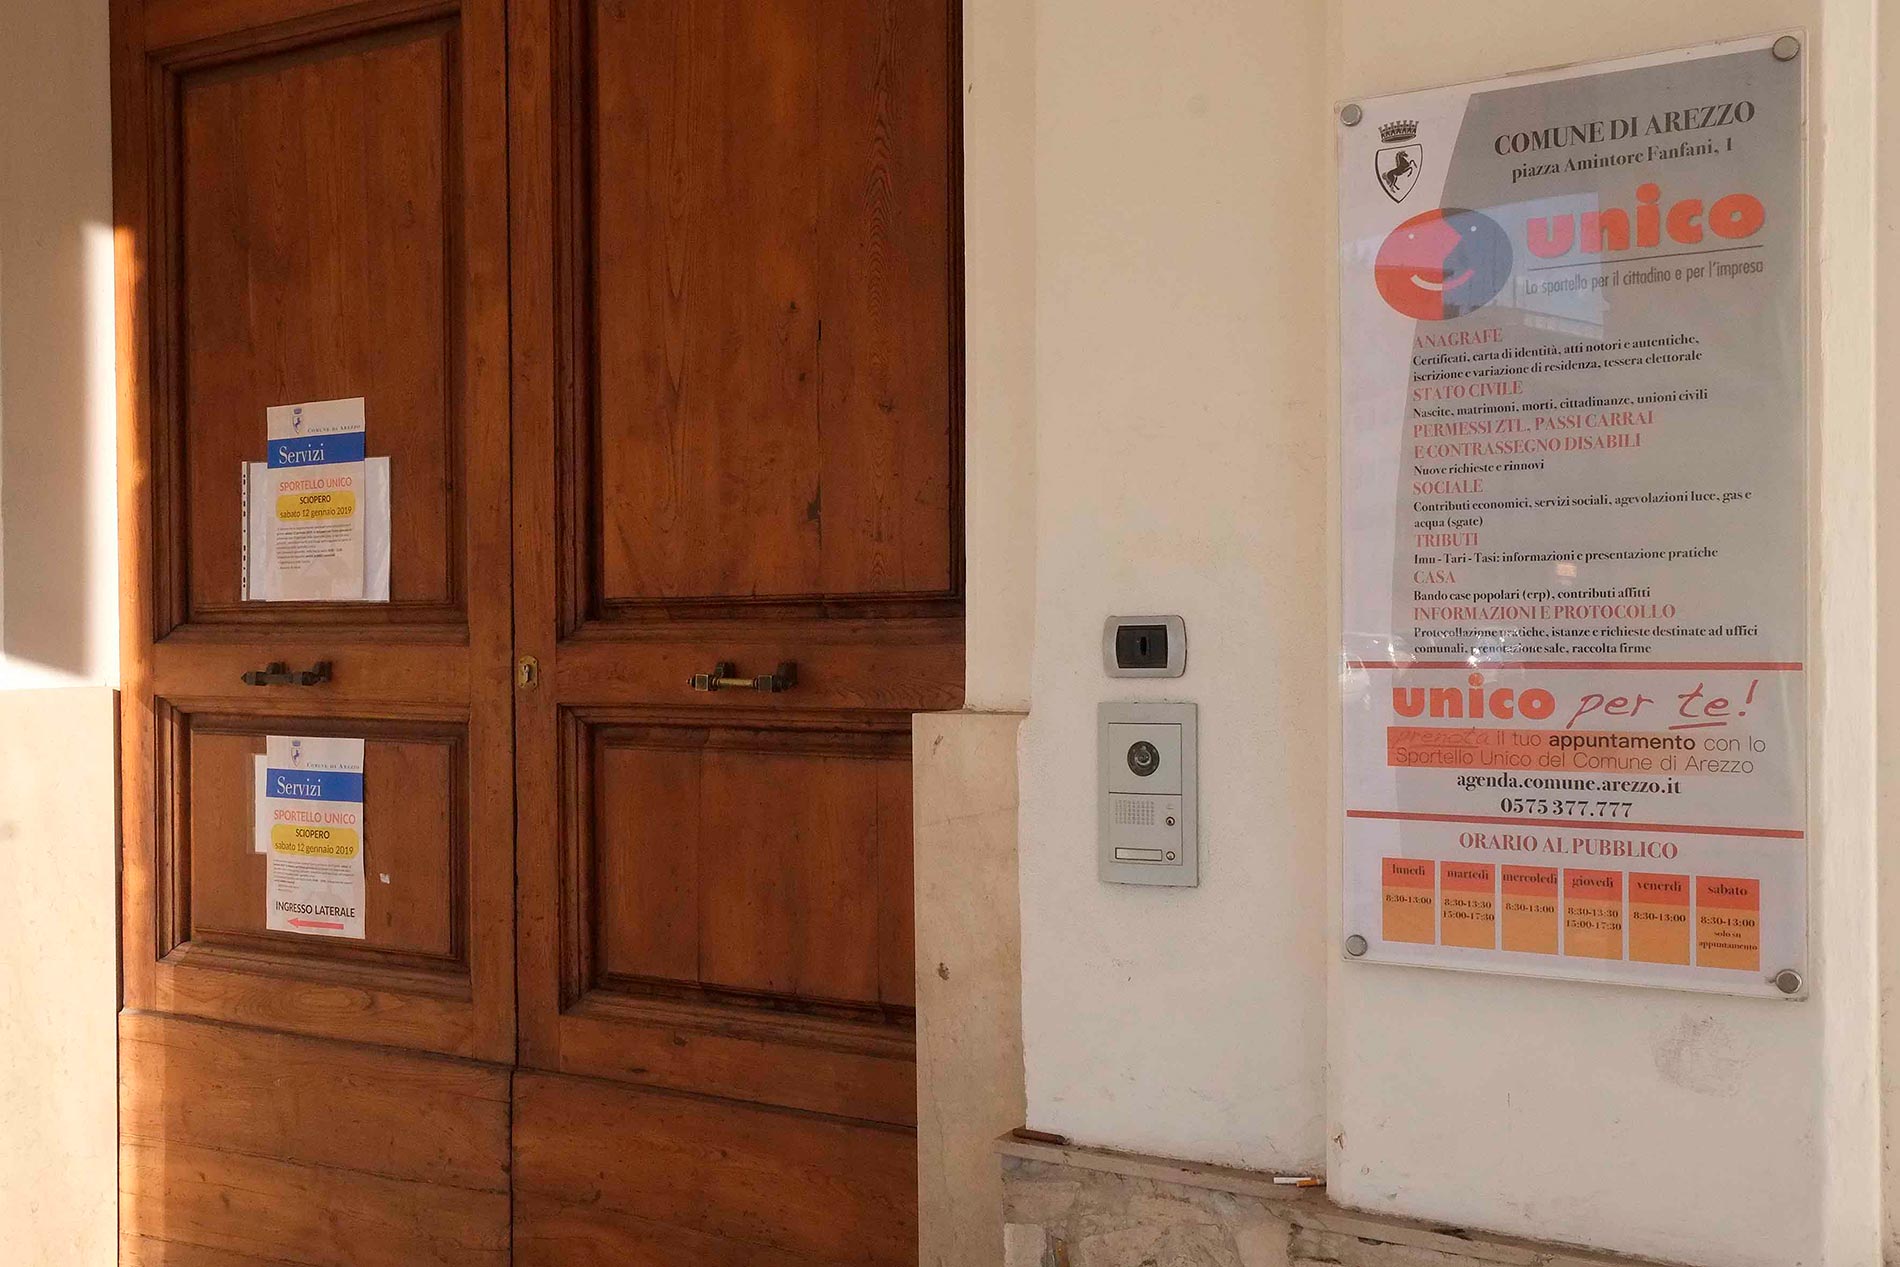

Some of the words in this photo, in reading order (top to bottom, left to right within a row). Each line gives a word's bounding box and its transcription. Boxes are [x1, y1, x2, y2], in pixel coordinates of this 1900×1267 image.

[1494, 120, 1606, 156] COMUNE
[1611, 119, 1639, 139] DI
[1645, 100, 1756, 136] AREZZO
[1511, 162, 1560, 183] piazza
[1564, 149, 1644, 173] Amintore
[1647, 139, 1720, 162] Fanfani,
[1525, 182, 1766, 259] unico
[1524, 280, 1538, 295] Lo
[1541, 272, 1588, 296] sportello
[1592, 273, 1610, 292] per
[1613, 270, 1619, 287] il
[1622, 266, 1672, 287] cittadino
[1675, 267, 1681, 280] e
[1685, 266, 1704, 286] per
[1708, 259, 1763, 283] l'impresa
[1413, 328, 1503, 349] ANAGRAFE
[1412, 350, 1471, 366] Certificati,
[1472, 349, 1499, 362] carta
[1501, 347, 1512, 359] di
[1514, 343, 1562, 358] identità,
[1564, 342, 1583, 354] atti
[1585, 339, 1621, 354] notori
[1623, 339, 1631, 350] e
[1632, 332, 1700, 350] autentiche,
[1413, 368, 1463, 382] iscrizione
[1464, 369, 1472, 379] e
[1472, 364, 1529, 379] variazione
[1531, 361, 1542, 374] di
[1544, 358, 1602, 374] residenza,
[1604, 354, 1643, 368] tessera
[1646, 349, 1702, 365] elettorale
[1412, 381, 1468, 402] STATO
[1469, 379, 1523, 398] CIVILE
[1413, 405, 1455, 419] Nascite,
[1457, 401, 1519, 416] matrimoni,
[1521, 396, 1557, 411] morti,
[1559, 393, 1634, 410] cittadinanze,
[1637, 390, 1676, 405] unioni
[1678, 388, 1708, 402] civili
[1413, 419, 1494, 438] PERMESSI
[1495, 416, 1531, 434] ZTL,
[1535, 414, 1582, 432] PASSI
[1585, 409, 1655, 428] CARRAI
[279, 443, 325, 464] Servizi
[1414, 444, 1424, 459] E
[1425, 436, 1564, 459] CONTRASSEGNO
[1564, 432, 1641, 451] DISABILI
[1413, 463, 1447, 476] Nuove
[1448, 459, 1495, 474] richieste
[1496, 462, 1502, 472] e
[1504, 458, 1545, 472] rinnovi
[280, 478, 325, 491] SPORTELLO
[326, 476, 352, 487] UNICO
[1412, 478, 1484, 496] SOCIALE
[299, 495, 331, 504] SCIOPERO
[1412, 498, 1471, 512] Contributi
[1472, 497, 1532, 512] economici,
[1534, 494, 1570, 509] servizi
[1572, 492, 1612, 508] sociali,
[1614, 490, 1689, 508] agevolazioni
[1691, 490, 1720, 504] luce,
[1722, 490, 1743, 503] gas
[1744, 489, 1752, 500] e
[279, 509, 301, 519] sabato
[302, 509, 309, 517] 12
[310, 507, 336, 519] gennaio
[337, 507, 352, 515] 2019
[1414, 517, 1445, 531] acqua
[1447, 515, 1484, 529] (sgate)
[1414, 532, 1479, 549] TRIBUTI
[1413, 552, 1435, 565] Imu
[1443, 552, 1466, 564] Tari
[1474, 551, 1500, 564] Tasi:
[1502, 549, 1576, 564] informazioni
[1577, 552, 1584, 562] e
[1584, 548, 1666, 564] presentazione
[1668, 546, 1718, 562] pratiche
[1413, 569, 1456, 585] CASA
[1413, 589, 1448, 602] Bando
[1449, 591, 1472, 602] case
[1472, 589, 1520, 603] popolari
[1522, 588, 1554, 602] (erp),
[1557, 586, 1616, 600] contributi
[1617, 586, 1651, 599] affitti
[1413, 604, 1539, 622] INFORMAZIONI
[1540, 605, 1551, 619] E
[1554, 603, 1676, 619] PROTOCOLLO
[1551, 625, 1591, 638] istanze
[1592, 628, 1599, 638] e
[1600, 624, 1651, 638] richieste
[1652, 624, 1707, 638] destinate
[1708, 624, 1722, 637] ad
[1724, 624, 1758, 637] uffici
[1414, 642, 1469, 654] comunali,
[1544, 642, 1569, 656] sale,
[1571, 642, 1617, 654] raccolta
[1619, 641, 1652, 654] firme
[1392, 673, 1556, 720] unico
[1566, 688, 1653, 729] per
[1668, 679, 1758, 730] te!
[1389, 725, 1491, 748] prenota
[1494, 729, 1504, 746] il
[1507, 730, 1542, 748] tuo
[1548, 731, 1695, 752] appuntamento
[1704, 735, 1740, 753] con
[1747, 734, 1766, 754] lo
[1395, 747, 1474, 768] Sportello
[1480, 750, 1531, 768] Unico
[1539, 752, 1566, 769] del
[1572, 752, 1652, 771] Comune
[1660, 755, 1677, 772] di
[1684, 755, 1754, 774] Arezzo
[277, 776, 321, 797] Servizi
[1456, 773, 1682, 795] agenda.comune.arezzo.it
[1500, 797, 1548, 816] 0575
[1552, 799, 1632, 818] 377.777
[274, 809, 321, 823] SPORTELLO
[325, 812, 356, 824] UNICO
[295, 828, 330, 839] SCIOPERO
[275, 842, 296, 852] sabato
[297, 843, 305, 852] 12
[306, 845, 334, 855] gennaio
[336, 846, 354, 855] 2019
[1458, 832, 1538, 853] ORARIO
[1542, 837, 1568, 855] AL
[1572, 838, 1679, 859] PUBBLICO
[1708, 884, 1748, 896] sabato
[1385, 894, 1432, 905] 8:30-13:00
[1444, 898, 1492, 909] 8:30-13:30
[1505, 903, 1555, 913] 8:30-13:00
[275, 901, 313, 914] INGRESSO
[315, 904, 355, 918] LATERALE
[1442, 911, 1495, 921] 15:00-17:30
[1567, 907, 1619, 918] 8:30-13:30
[1633, 911, 1686, 922] 8:30-13:00
[1565, 919, 1622, 931] 15:00-17:30
[1700, 915, 1755, 927] 8:30-13:00
[1714, 930, 1731, 938] solo
[1698, 941, 1758, 951] appuntamento
